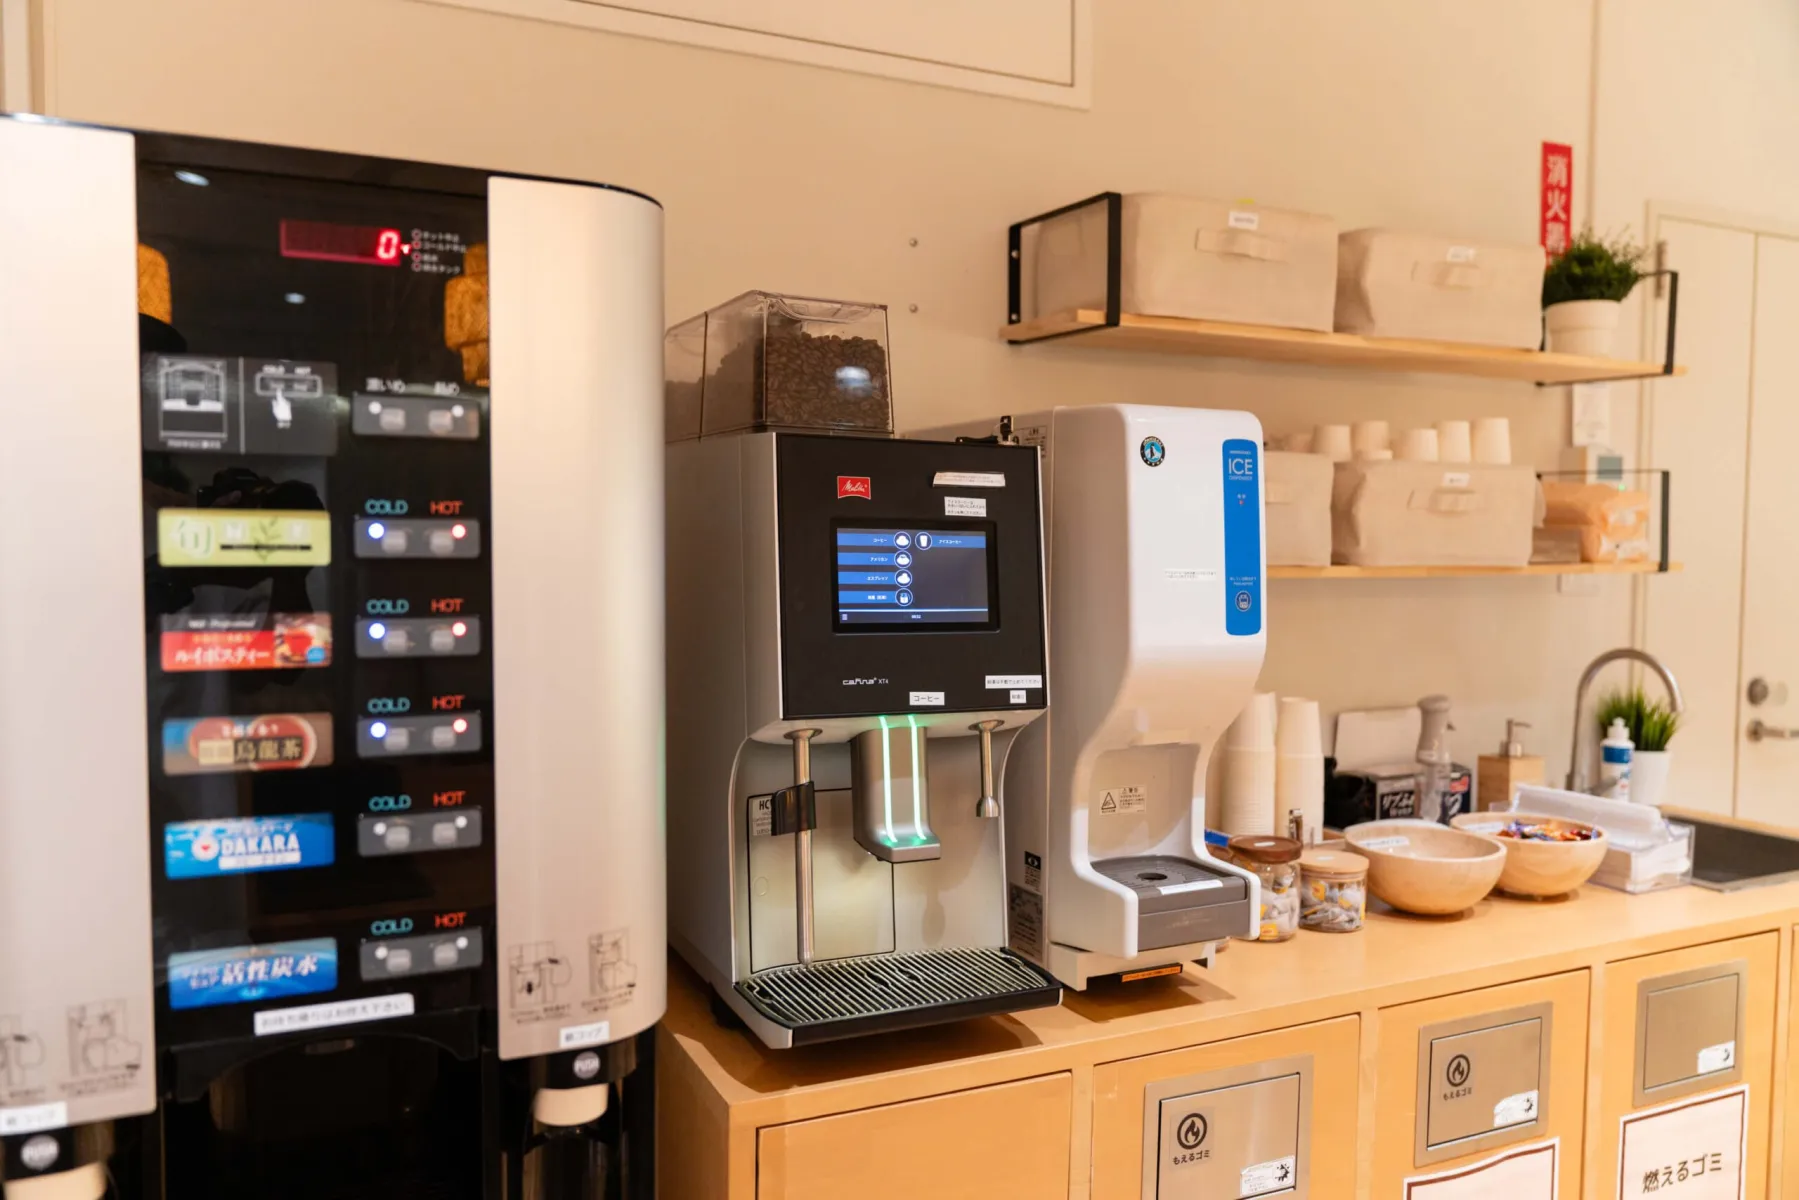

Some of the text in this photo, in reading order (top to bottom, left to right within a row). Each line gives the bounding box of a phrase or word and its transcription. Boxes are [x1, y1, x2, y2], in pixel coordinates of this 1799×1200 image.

[377, 229, 398, 260] 0
[1228, 458, 1253, 475] ICE
[365, 500, 463, 515] COLD HOT
[366, 598, 464, 614] COLD HOT
[175, 646, 270, 665] ルイボスティー
[367, 695, 465, 713] COLD HOT
[913, 695, 940, 703] コーヒー
[368, 791, 466, 811] COLD HOT
[221, 833, 300, 856] DAKARA
[370, 912, 467, 935] COLD HOT
[222, 953, 318, 986] 活性炭水
[1443, 1087, 1472, 1101] もえるゴミ
[1173, 1150, 1210, 1165] もえるゴミ
[1642, 1153, 1722, 1194] 燃えるゴミ
